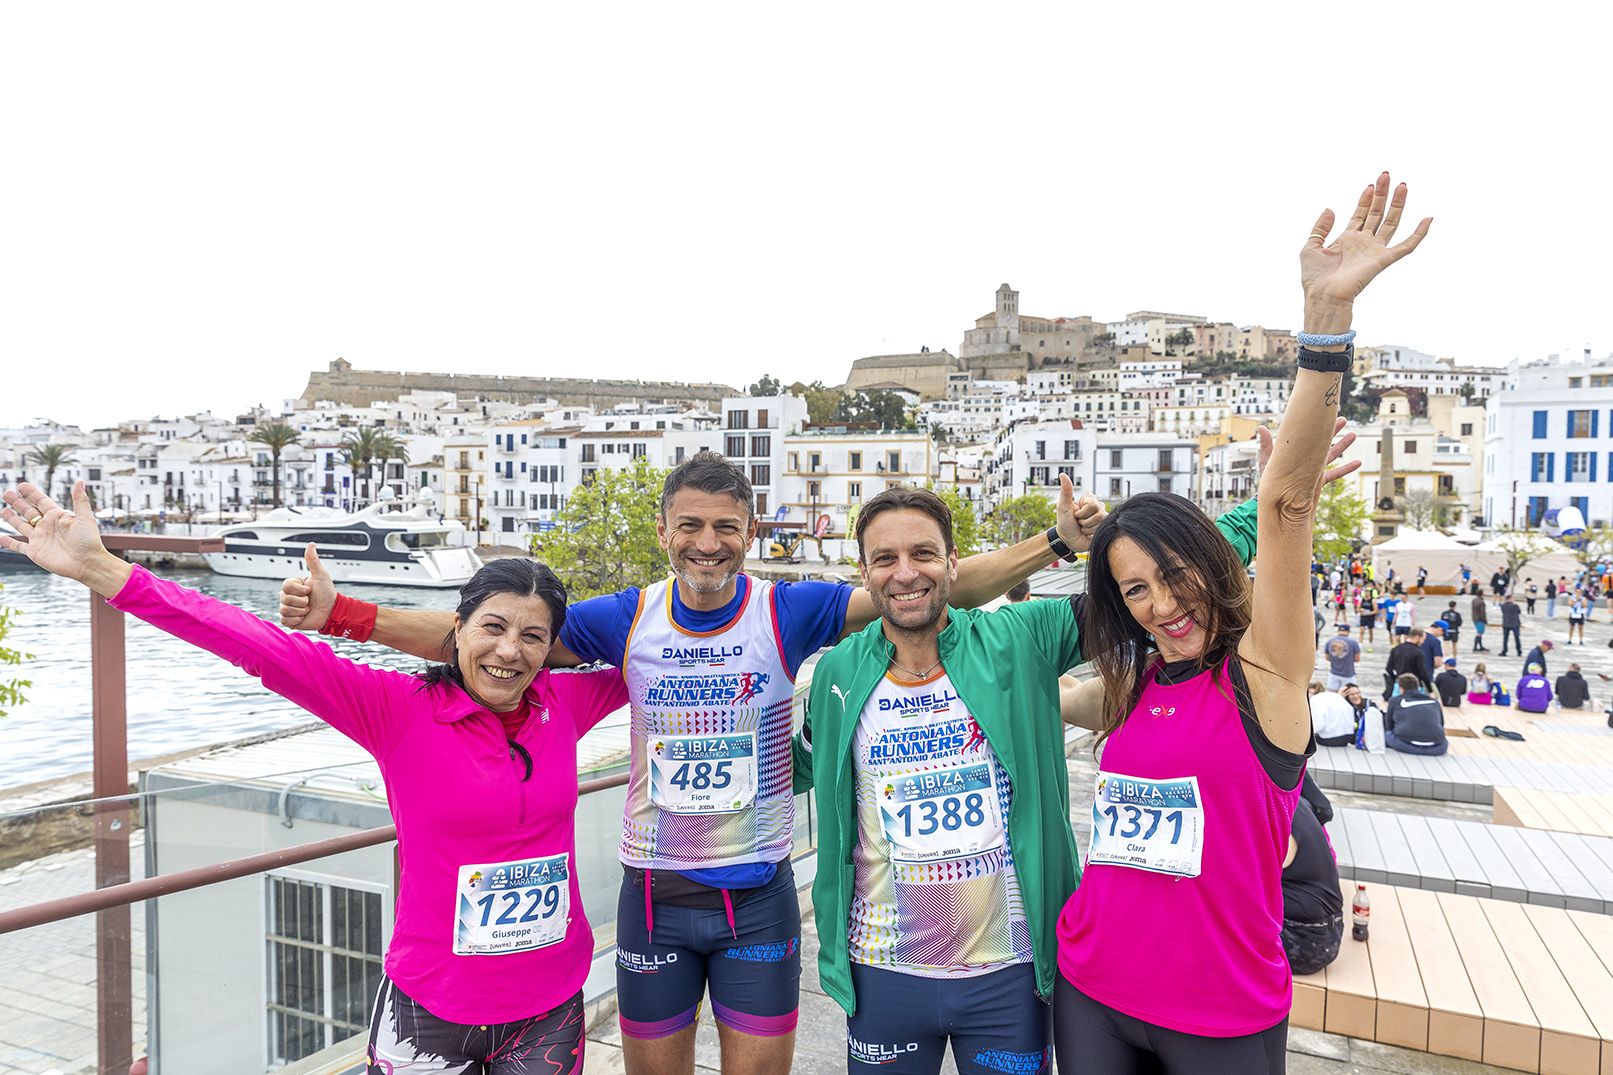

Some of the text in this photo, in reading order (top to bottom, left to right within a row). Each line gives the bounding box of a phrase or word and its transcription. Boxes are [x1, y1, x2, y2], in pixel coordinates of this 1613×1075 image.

[662, 645, 743, 659] DANIELLO
[657, 677, 739, 689] ANTONIANA
[647, 687, 737, 701] RUNNERS
[879, 690, 961, 711] DANIELL
[644, 699, 700, 707] SANT'ANTONIO
[900, 702, 949, 716] SPORTS WEAR
[879, 722, 967, 744] ANTONIANA
[688, 739, 729, 752] IBIZA
[870, 734, 964, 759] RUNNERS
[688, 751, 729, 759] MARATHON
[868, 749, 959, 766] SANT'ANTONIO ABATE
[670, 760, 732, 791] 485
[920, 771, 965, 789] IBIZA
[922, 783, 966, 798] MARATHON
[1123, 781, 1164, 800] IBIZA
[1123, 795, 1166, 806] MARATHON
[897, 793, 985, 837] 1388
[1104, 804, 1183, 845] 1371
[1126, 843, 1146, 853] Clara
[510, 862, 550, 880] IBIZA
[509, 873, 550, 888] MARATHON
[477, 884, 560, 927] 1229
[492, 926, 531, 940] Giuseppe
[617, 944, 678, 966] ANIELLO
[727, 948, 785, 960] RUNNERS
[847, 1030, 918, 1056] ANIELLO
[850, 1048, 897, 1061] SPORTS WEAR
[976, 1053, 1041, 1071] RUNNERS
[984, 1050, 1042, 1063] ANTONIANA
